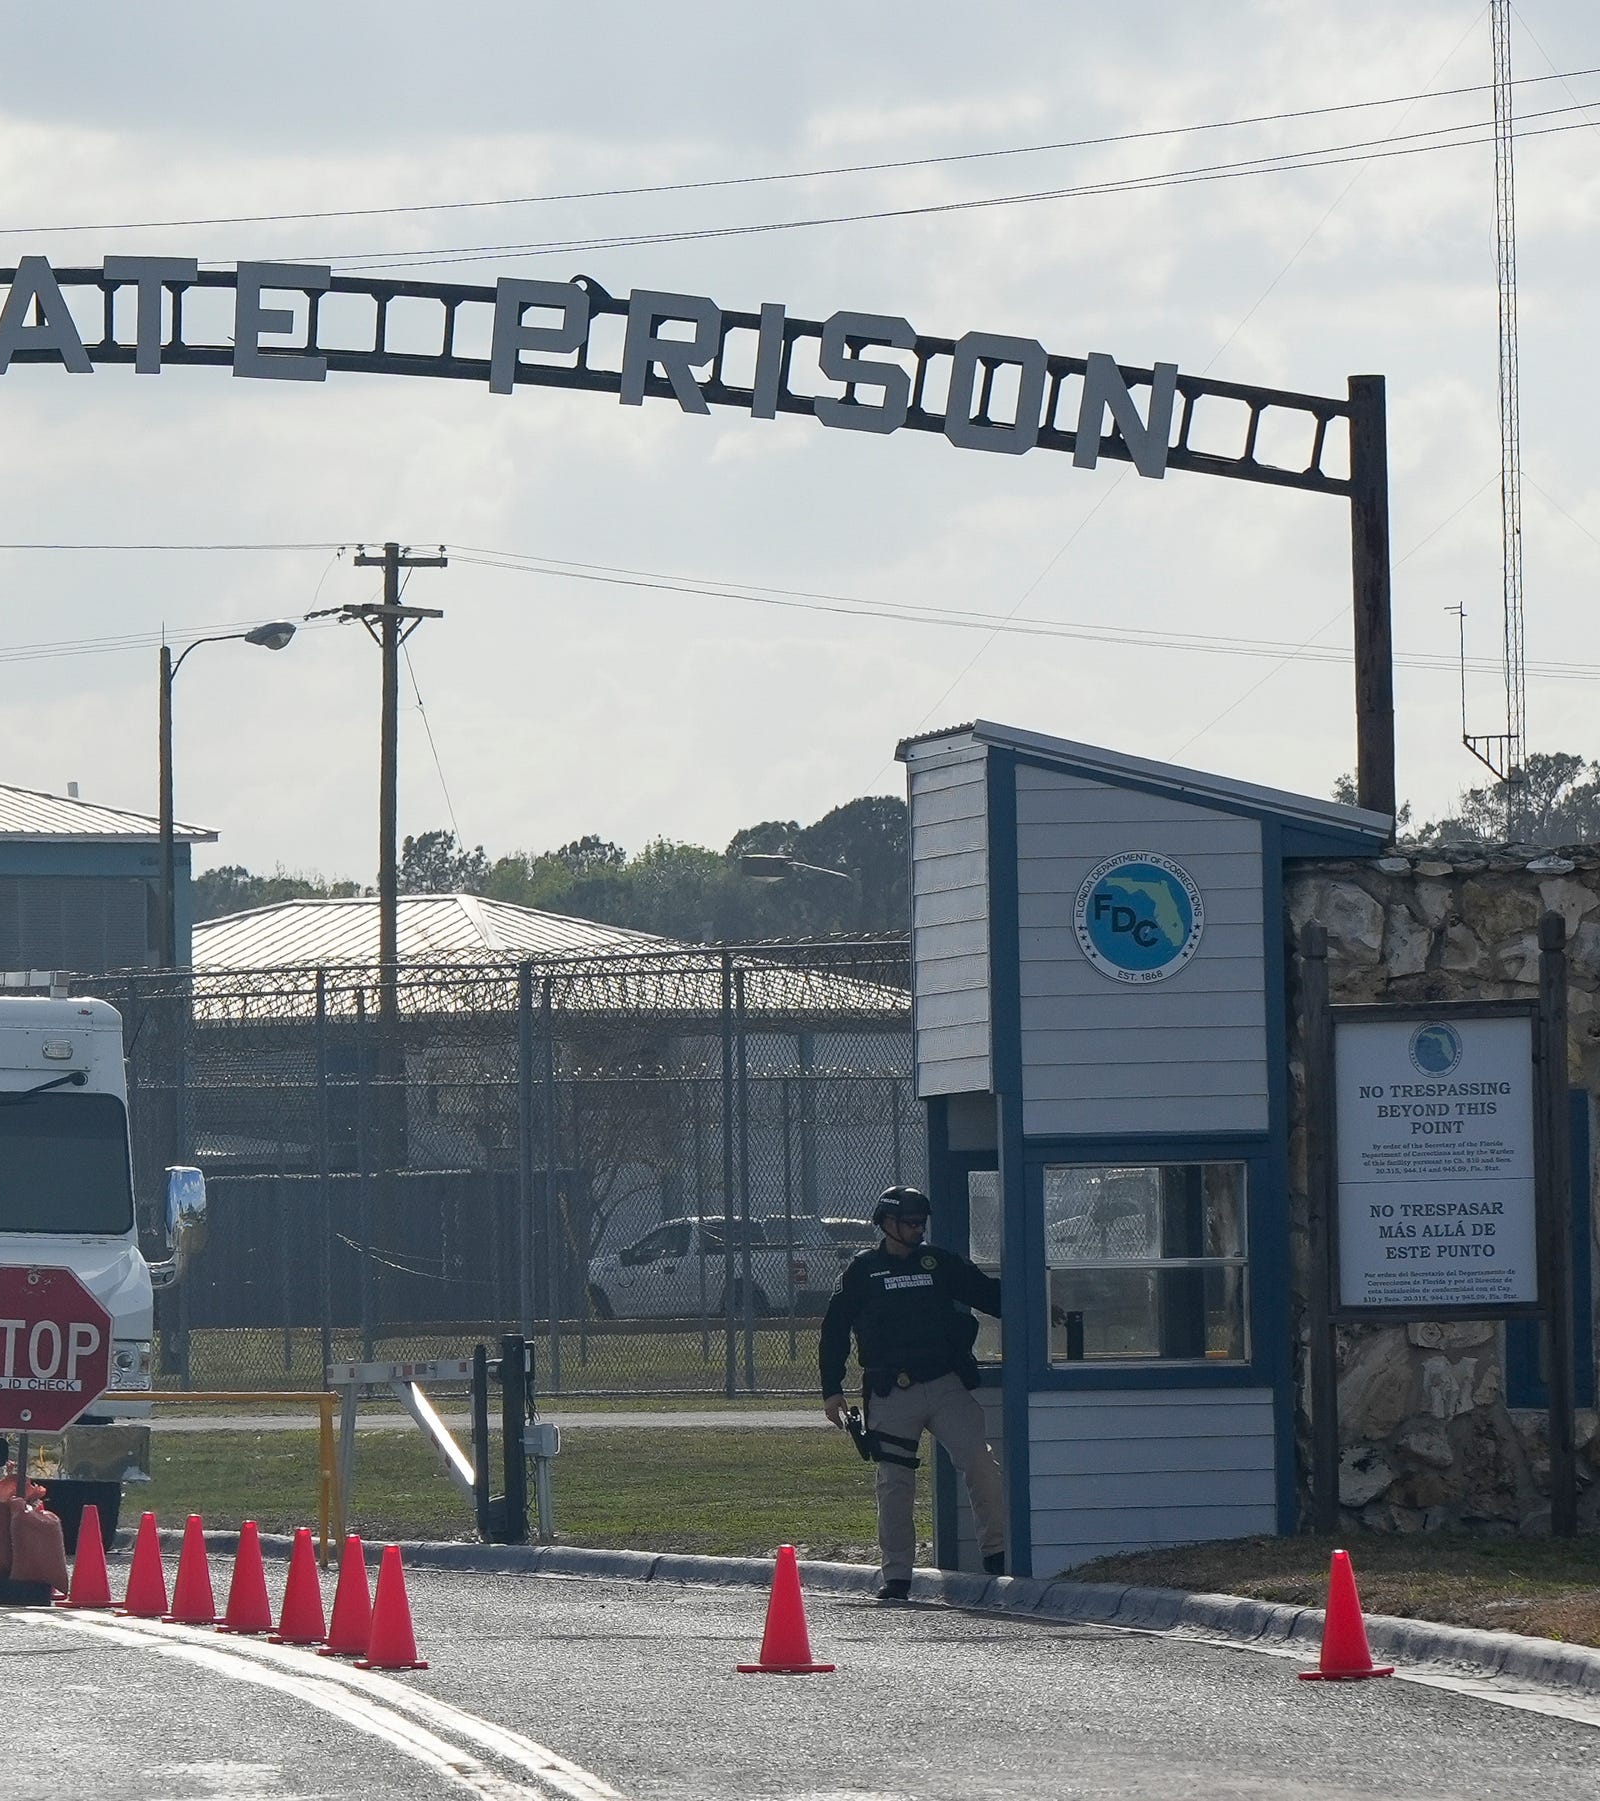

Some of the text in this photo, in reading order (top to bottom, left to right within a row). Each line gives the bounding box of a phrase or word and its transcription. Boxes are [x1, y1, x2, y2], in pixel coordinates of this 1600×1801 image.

[489, 277, 1178, 479] PRISON
[1076, 853, 1202, 918] FLORIDA DEPARTMENT OF CORRECTIONS
[1094, 893, 1158, 948] FDC
[1117, 970, 1163, 981] EST. 1868
[1359, 1082, 1511, 1098] NO TRESPASSING
[1377, 1101, 1497, 1118] BEYOND THIS
[1410, 1120, 1464, 1134] POINT
[1369, 1202, 1504, 1218] NO TRESPASAR
[1379, 1220, 1496, 1239] MÁS ALLÁ DE
[1385, 1244, 1496, 1260] ESTE PUNTO
[9, 1378, 21, 1389] ID
[27, 1379, 75, 1391] CHECK
